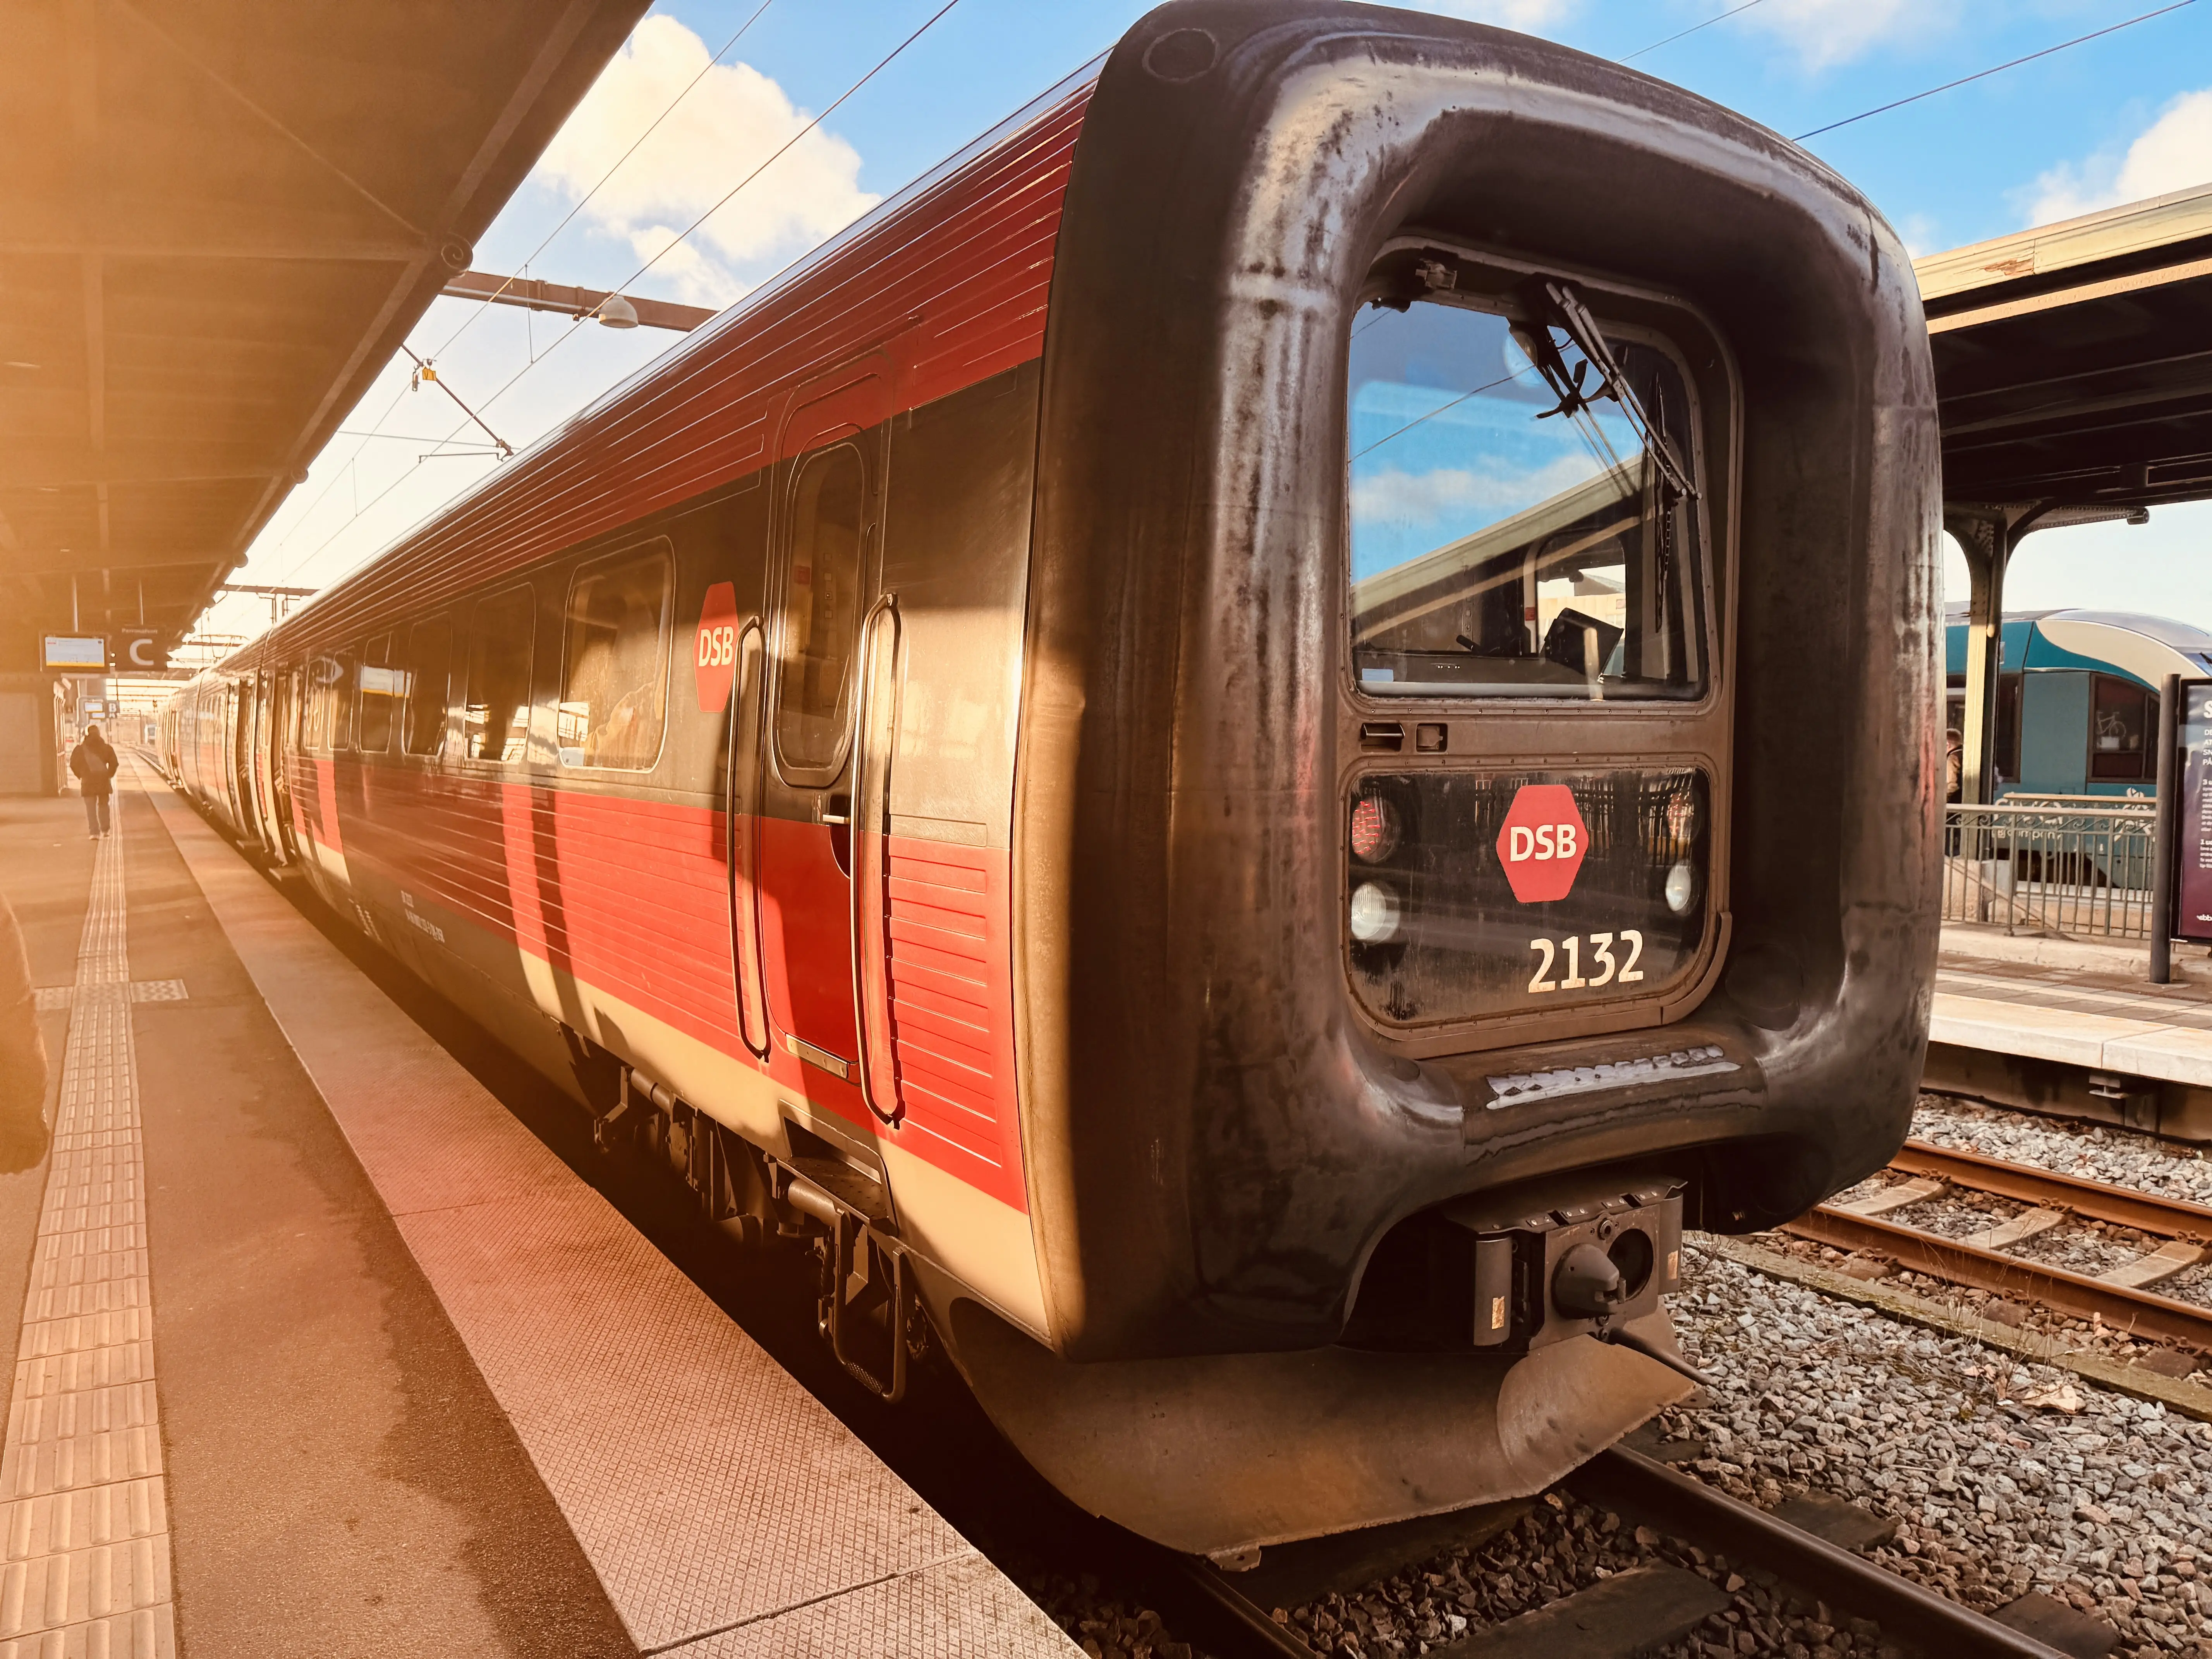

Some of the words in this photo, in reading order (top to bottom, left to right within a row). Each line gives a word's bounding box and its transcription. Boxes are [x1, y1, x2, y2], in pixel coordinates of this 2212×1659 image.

[129, 638, 154, 666] C
[698, 626, 734, 667] DSB
[1510, 824, 1577, 862] DSB
[2007, 830, 2063, 841] cmpn
[1528, 929, 1644, 993] 2132
